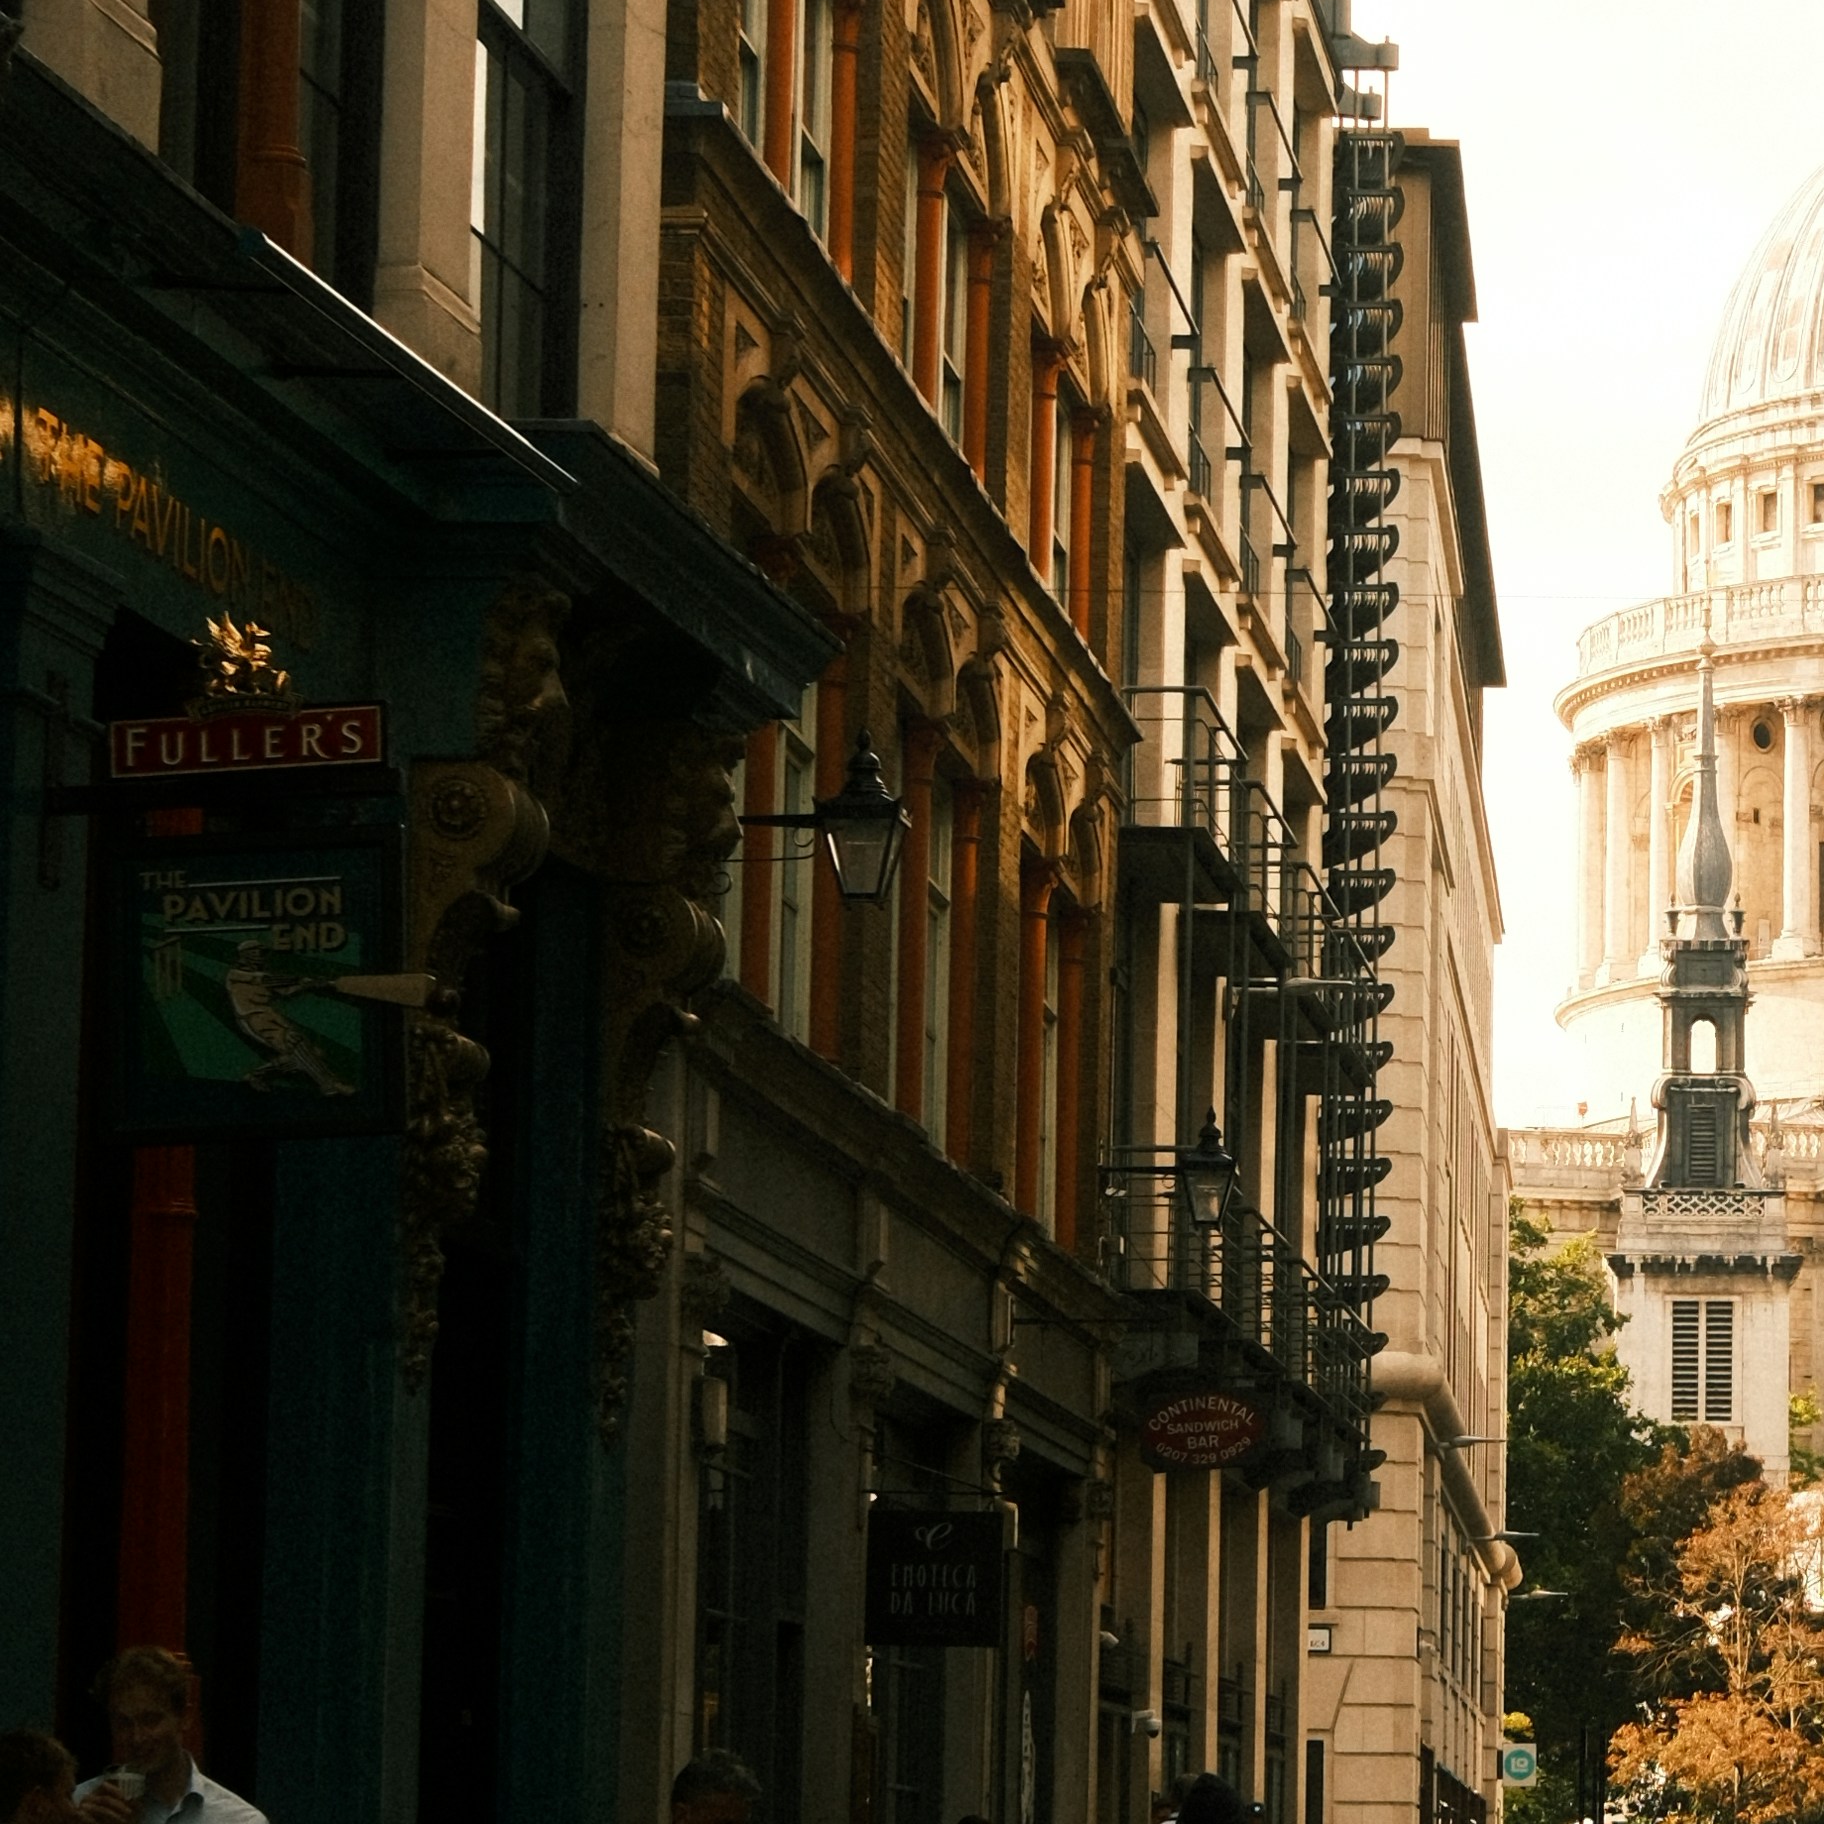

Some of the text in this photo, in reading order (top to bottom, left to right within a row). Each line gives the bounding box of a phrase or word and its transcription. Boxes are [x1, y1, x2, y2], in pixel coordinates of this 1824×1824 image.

[116, 460, 250, 616] PAVILION
[124, 713, 364, 768] FULLER'S
[139, 869, 188, 892] THE
[162, 885, 343, 923] PAVILION
[270, 922, 347, 952] END
[1148, 1395, 1255, 1431] CONTINENTAL
[1166, 1419, 1239, 1435] SANDWICH
[1155, 1436, 1252, 1464] 0207 329 0929
[1186, 1434, 1219, 1450] BAR
[890, 1563, 977, 1589] ENOTECA
[890, 1590, 976, 1616] DA LUCA
